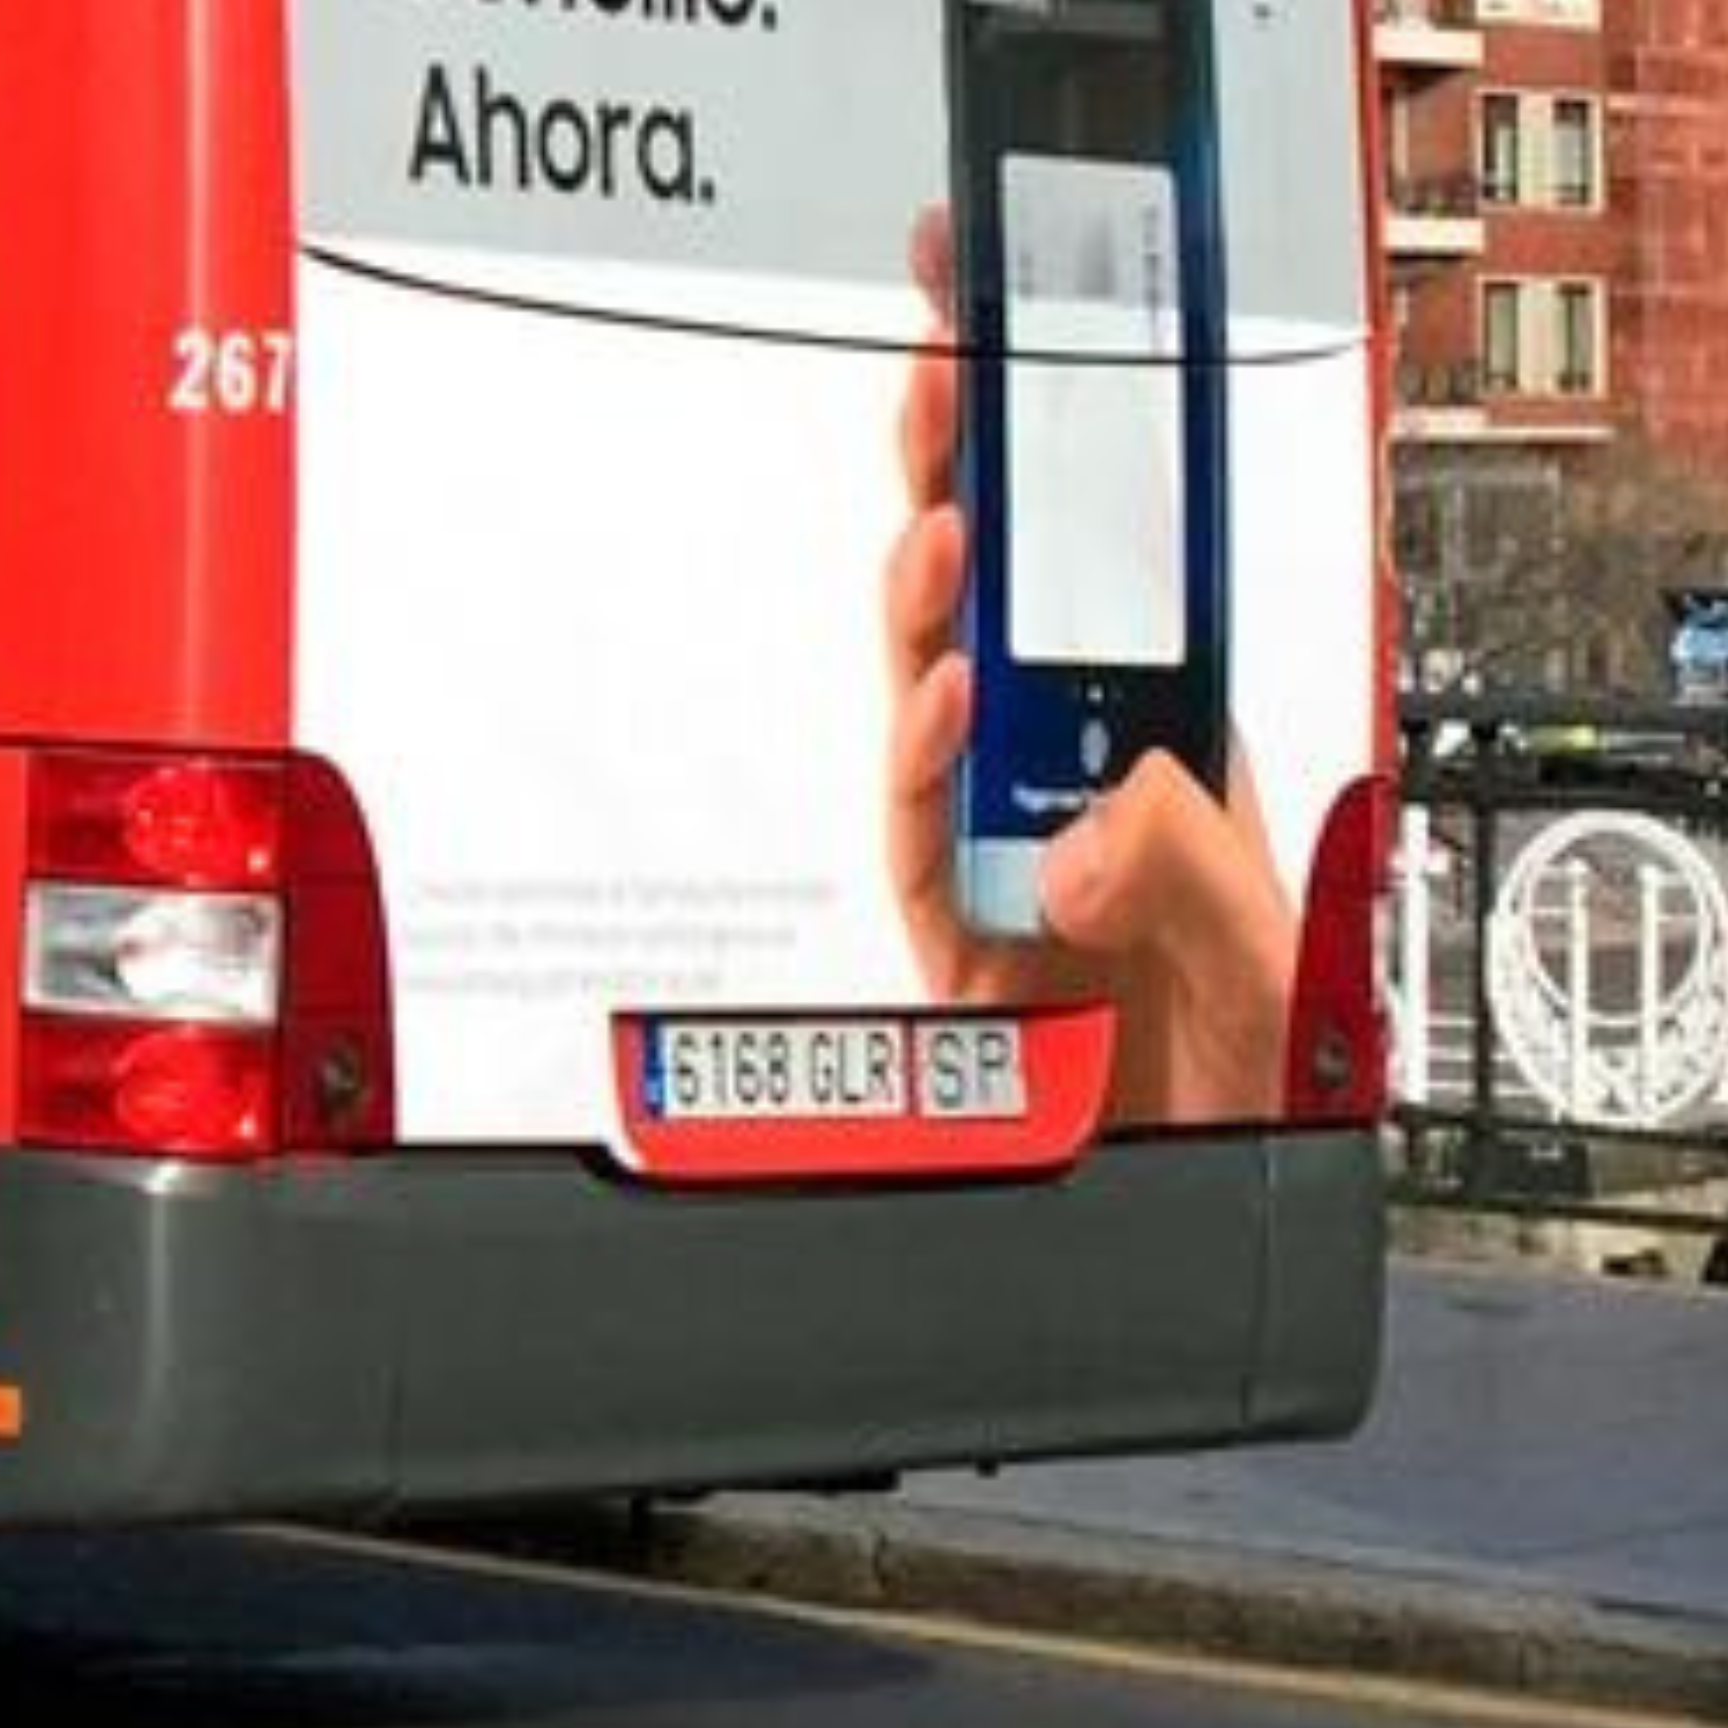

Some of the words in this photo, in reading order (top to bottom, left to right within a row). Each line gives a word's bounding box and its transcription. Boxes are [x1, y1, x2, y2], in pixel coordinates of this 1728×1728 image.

[406, 61, 718, 204] Ahora.
[167, 326, 294, 412] 267
[673, 1030, 791, 1107] 6168
[808, 1030, 896, 1105] GLR
[929, 1030, 1013, 1110] SP
